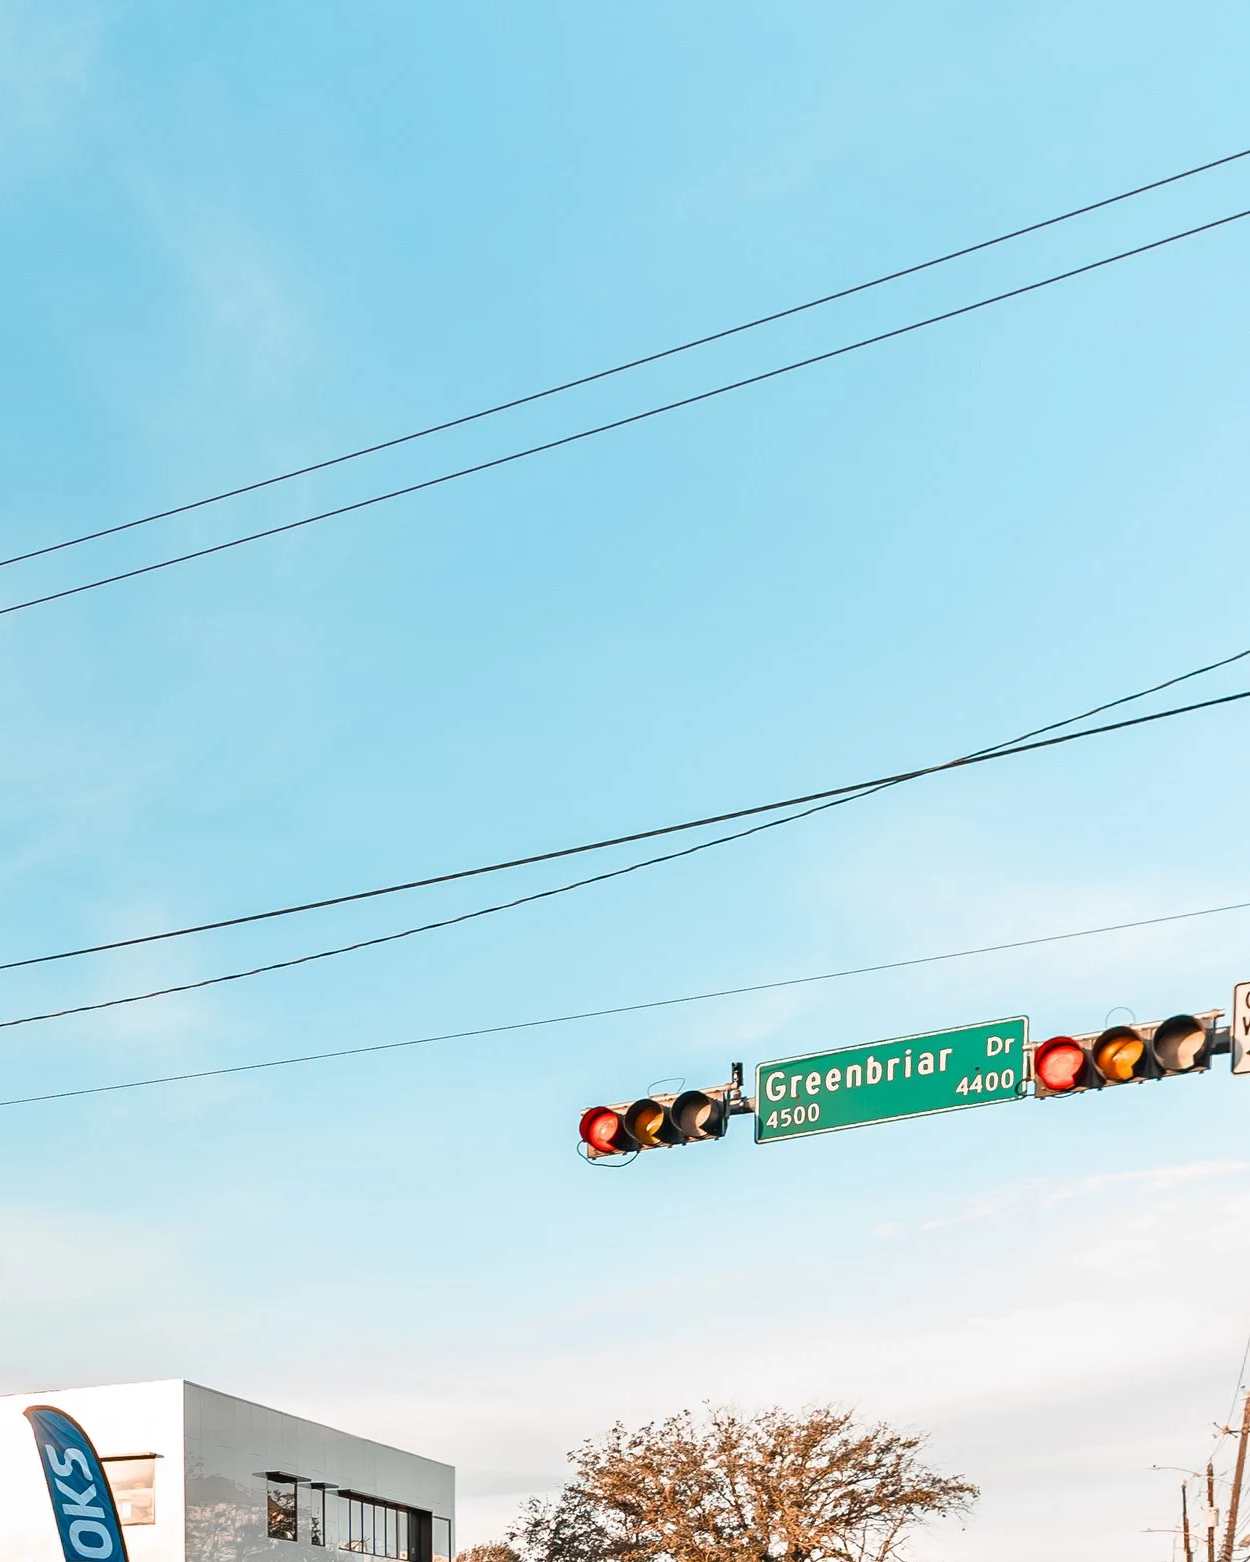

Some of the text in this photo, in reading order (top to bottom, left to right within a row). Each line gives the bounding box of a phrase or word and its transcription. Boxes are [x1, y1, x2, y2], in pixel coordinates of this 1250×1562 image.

[765, 1036, 1015, 1101] Greenbriar Dr
[955, 1069, 1014, 1096] 4400
[765, 1103, 820, 1129] 4500
